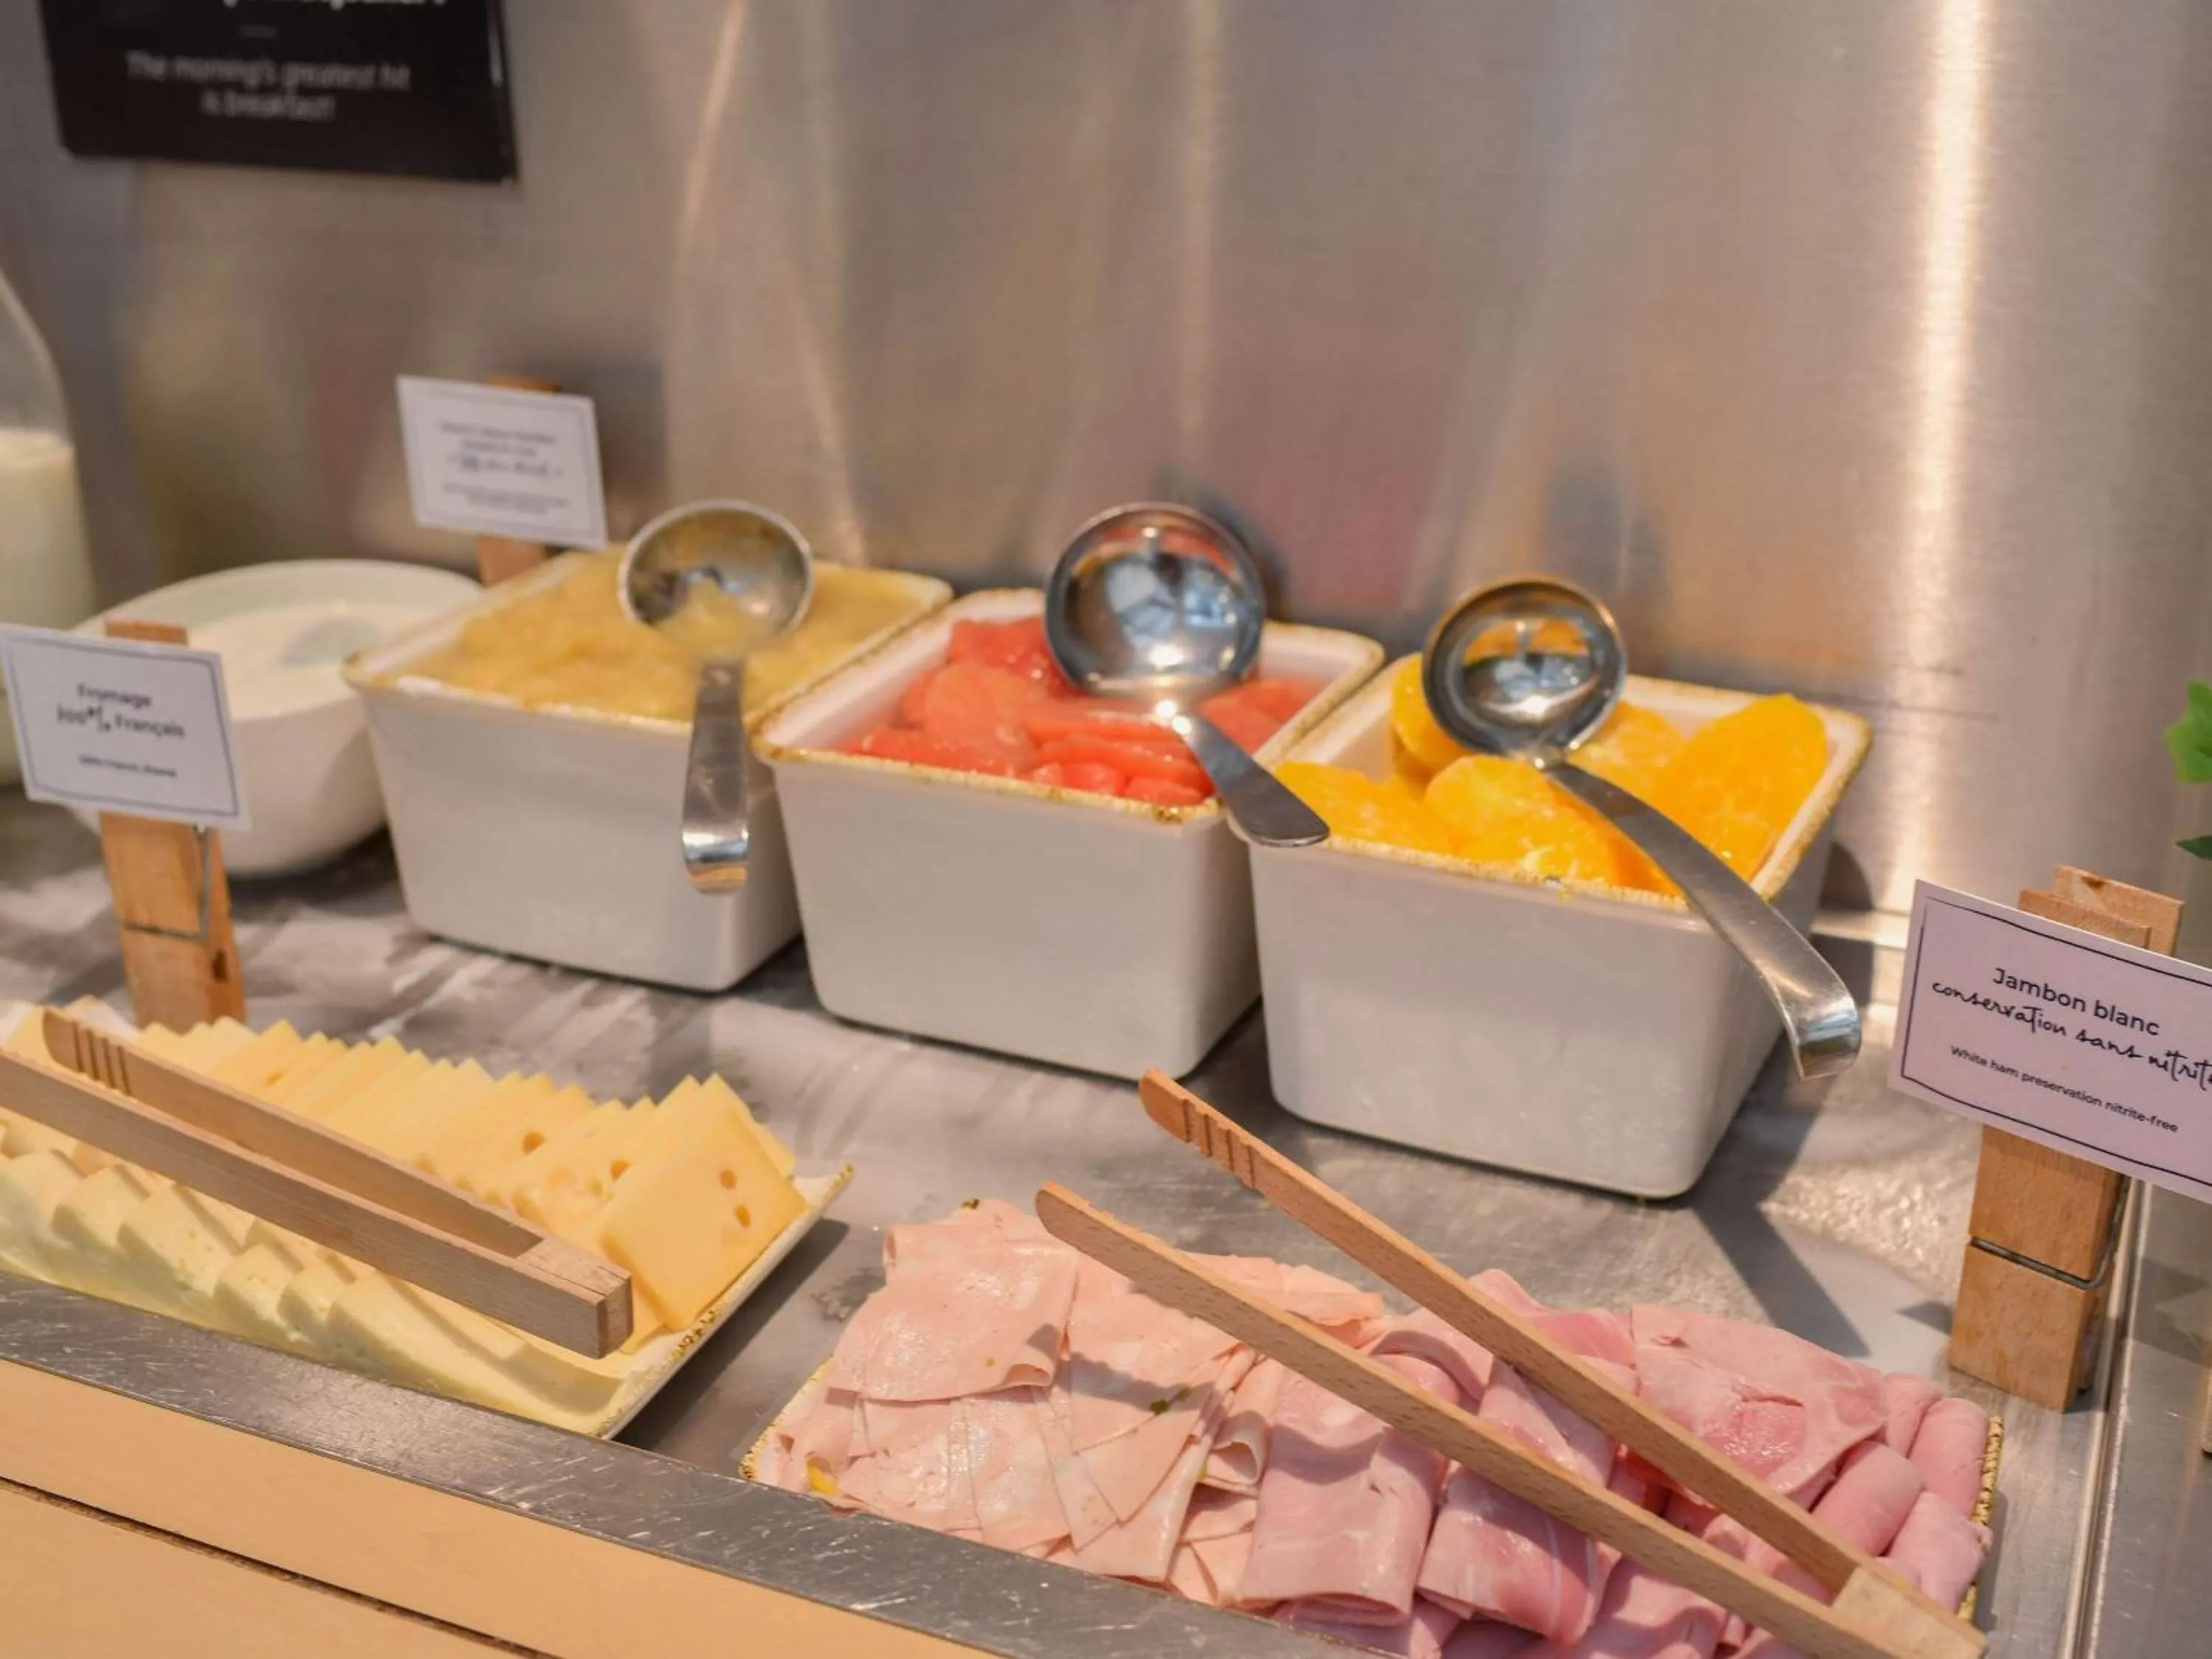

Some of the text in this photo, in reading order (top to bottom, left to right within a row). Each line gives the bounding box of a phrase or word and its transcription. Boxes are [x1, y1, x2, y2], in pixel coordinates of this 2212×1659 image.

[76, 683, 152, 709] Fromage
[1932, 981, 2067, 1037] conservation
[2076, 1029, 2143, 1060] sans
[1993, 967, 2161, 1037] Jambon blanc
[1950, 1044, 2179, 1133] White ham preservation nitrite-free
